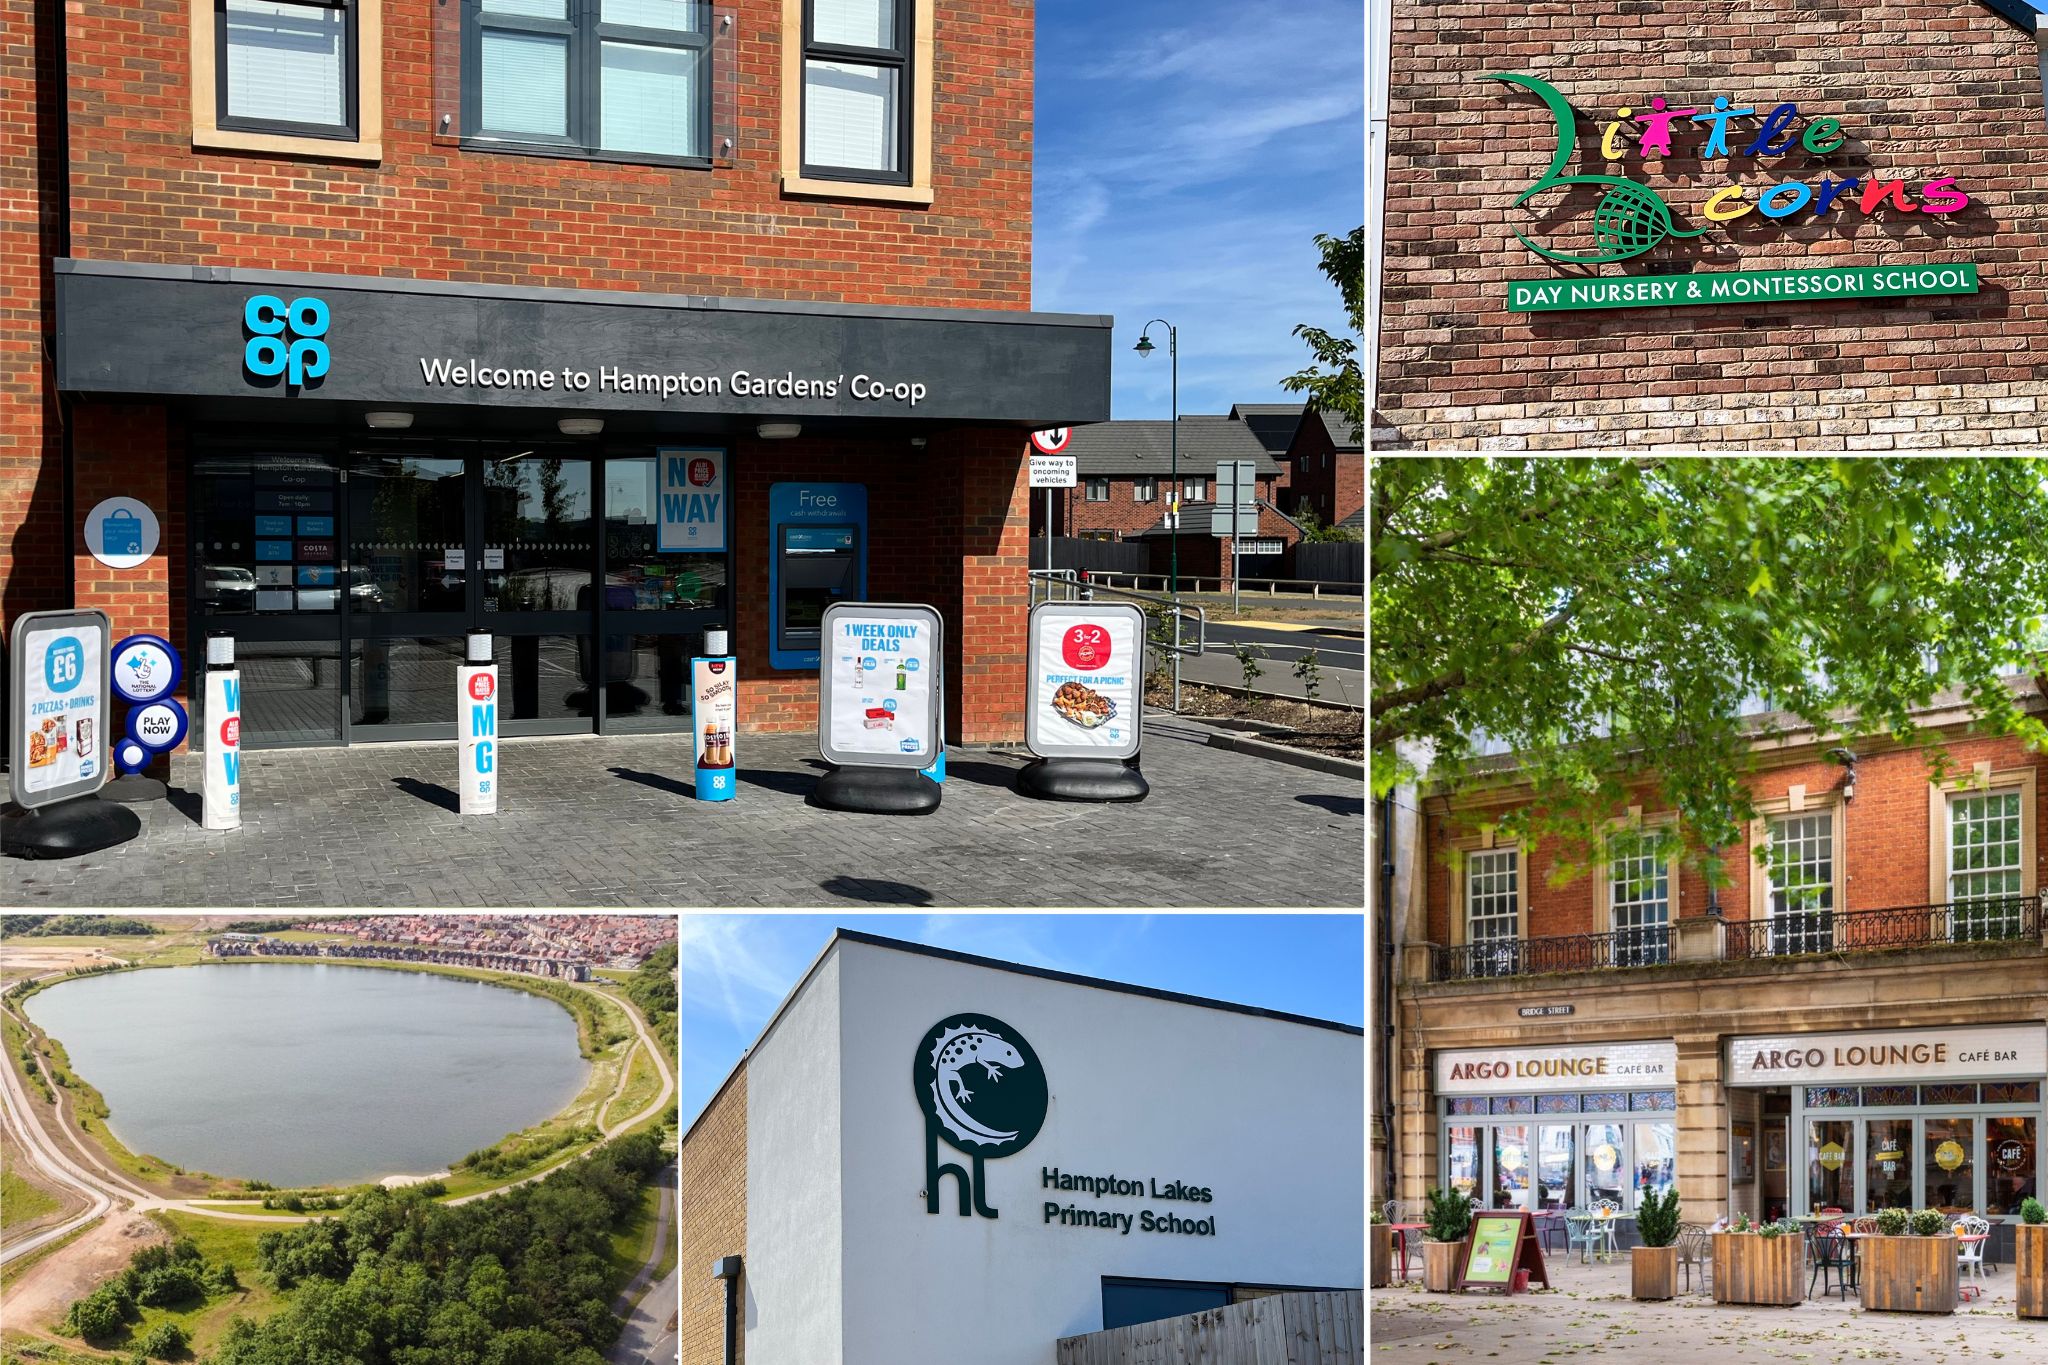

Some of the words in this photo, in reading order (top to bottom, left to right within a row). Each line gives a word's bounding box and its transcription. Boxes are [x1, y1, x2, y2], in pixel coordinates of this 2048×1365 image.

[1515, 286, 1563, 306] DAY
[1571, 281, 1678, 303] NURSERY
[1687, 281, 1703, 298] &
[1711, 273, 1864, 299] MONTESSORI
[1873, 269, 1971, 291] SCHOOL
[421, 358, 557, 390] Welcome
[563, 364, 591, 391] to
[598, 365, 723, 401] Hampton
[851, 375, 927, 404] Co-op
[282, 475, 306, 483] Co-op
[1033, 468, 1070, 476] oncoming
[800, 490, 837, 507] Free
[663, 493, 721, 523] WAY
[790, 509, 805, 517] cash
[807, 509, 846, 518] withdrawals
[845, 624, 850, 636] 1
[852, 624, 885, 637] WEEK
[888, 625, 918, 638] ONLY
[1074, 629, 1084, 643] 3
[1091, 630, 1101, 643] 2
[862, 639, 900, 651] DEALS
[53, 653, 77, 684] £6
[1047, 675, 1078, 683] PERFECT
[31, 703, 37, 715] 2
[38, 699, 64, 714] PIZZAS
[69, 695, 95, 709] DRINKS
[143, 717, 171, 726] PLAY
[143, 726, 171, 735] NOW
[1522, 1008, 1544, 1016] BRIDGE
[1548, 1006, 1570, 1014] STREET
[1752, 1049, 1824, 1070] ARGO
[1834, 1043, 1946, 1067] LOUNGE
[1959, 1050, 1990, 1062] CAFÉ
[1995, 1050, 2017, 1061] BAR
[1450, 1062, 1509, 1080] ARGO
[1516, 1057, 1607, 1077] LOUNGE
[1616, 1064, 1642, 1075] CAFÉ
[1645, 1064, 1664, 1074] BAR
[2002, 1145, 2021, 1159] CAFÉ
[1883, 1161, 1896, 1171] BAR
[1042, 1166, 1144, 1198] Hampton
[1151, 1177, 1213, 1203] Lakes
[1044, 1201, 1133, 1235] Primary
[1140, 1210, 1216, 1236] School
